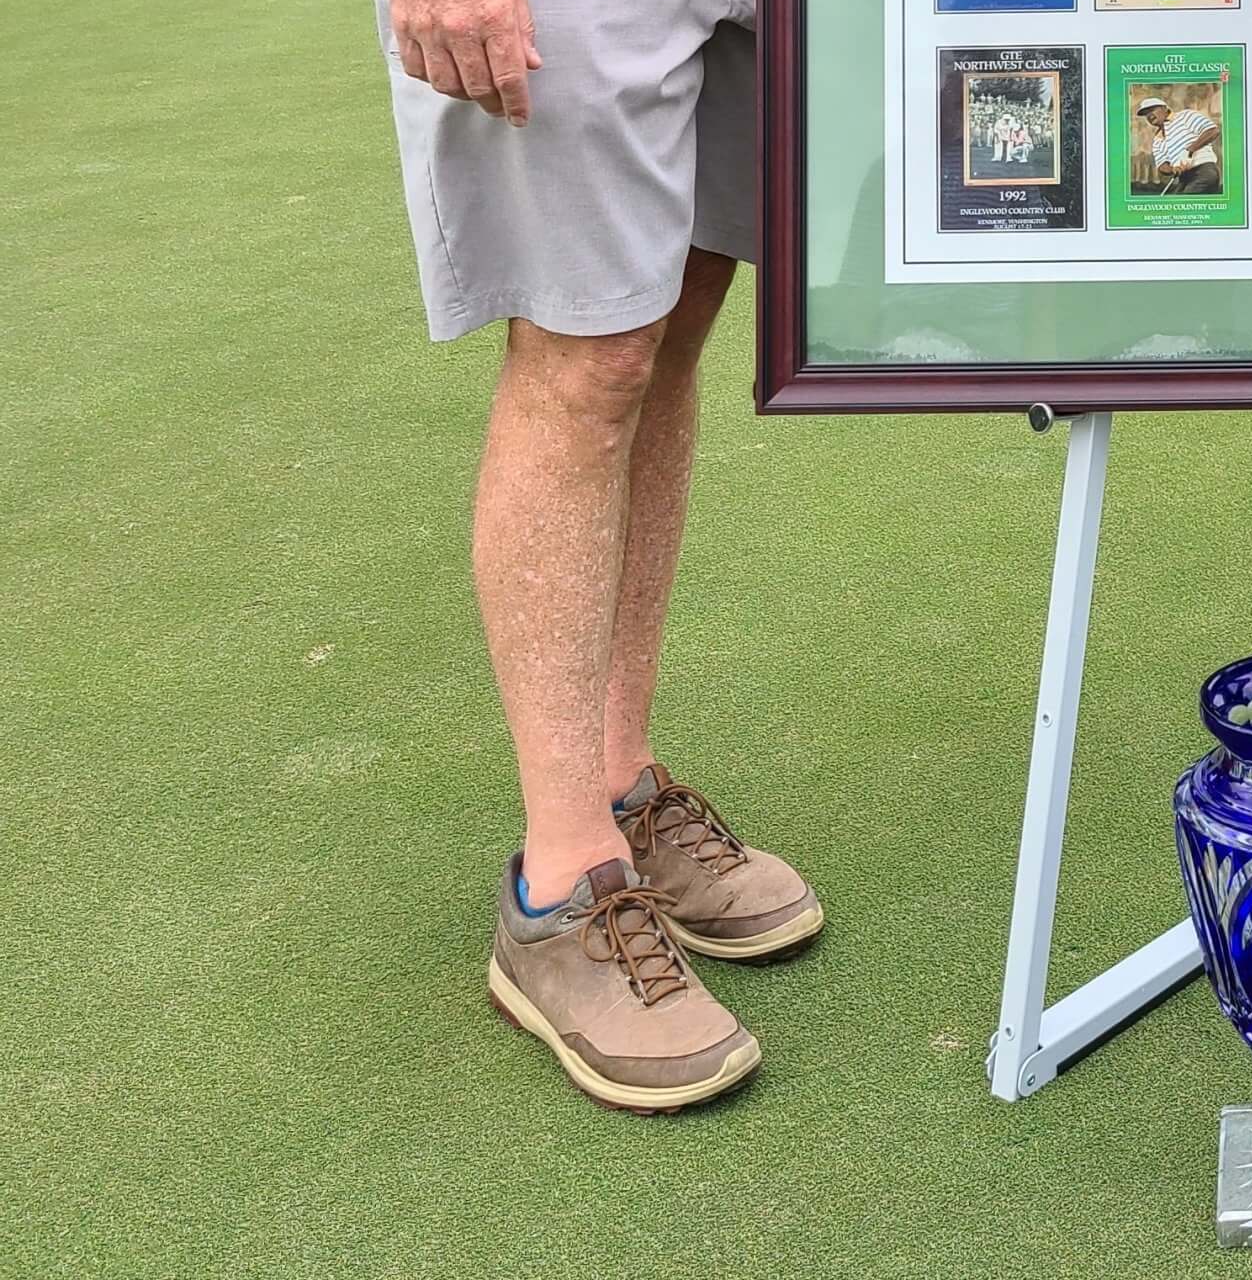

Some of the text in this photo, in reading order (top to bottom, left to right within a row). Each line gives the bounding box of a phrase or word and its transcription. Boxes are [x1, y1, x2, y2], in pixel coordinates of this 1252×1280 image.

[1000, 52, 1022, 60] GTE
[1165, 55, 1186, 63] GTE
[954, 60, 1069, 71] NORTHWEST CLASSIC
[1121, 63, 1230, 73] NORTHWEST CLASSIC
[1000, 191, 1026, 201] 1992
